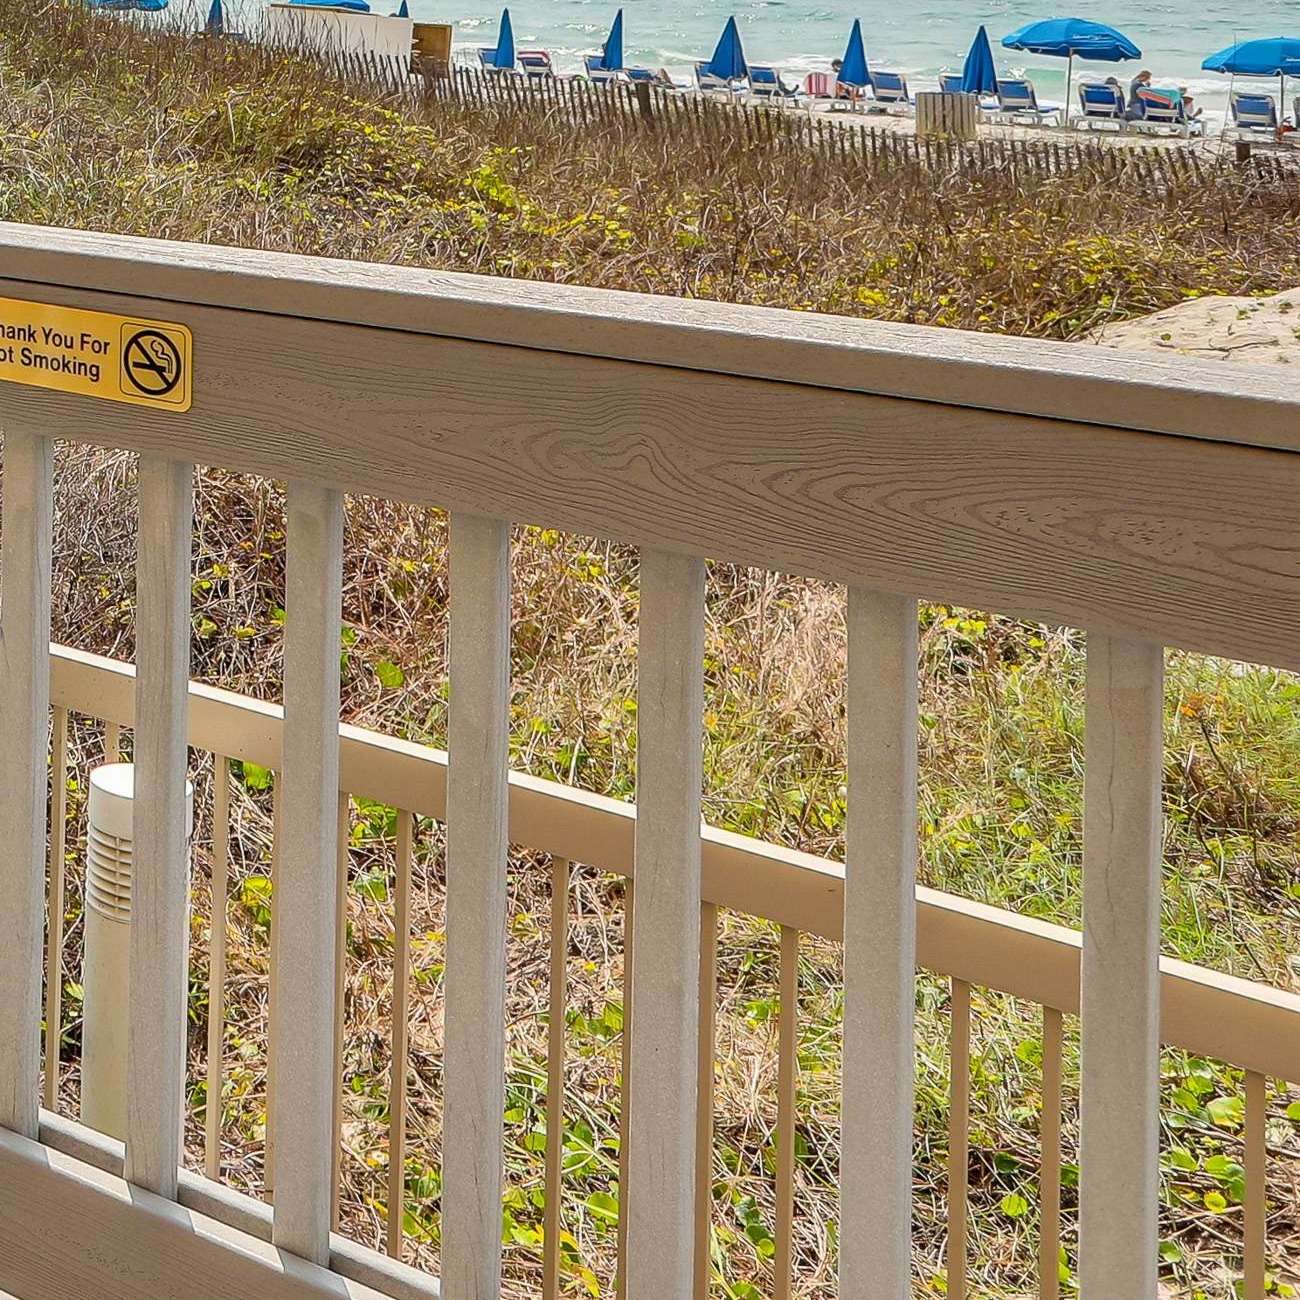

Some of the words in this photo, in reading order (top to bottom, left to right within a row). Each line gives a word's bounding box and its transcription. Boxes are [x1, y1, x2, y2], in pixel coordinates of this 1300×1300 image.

[41, 326, 74, 349] You
[80, 333, 111, 355] For
[20, 347, 101, 383] Smoking
